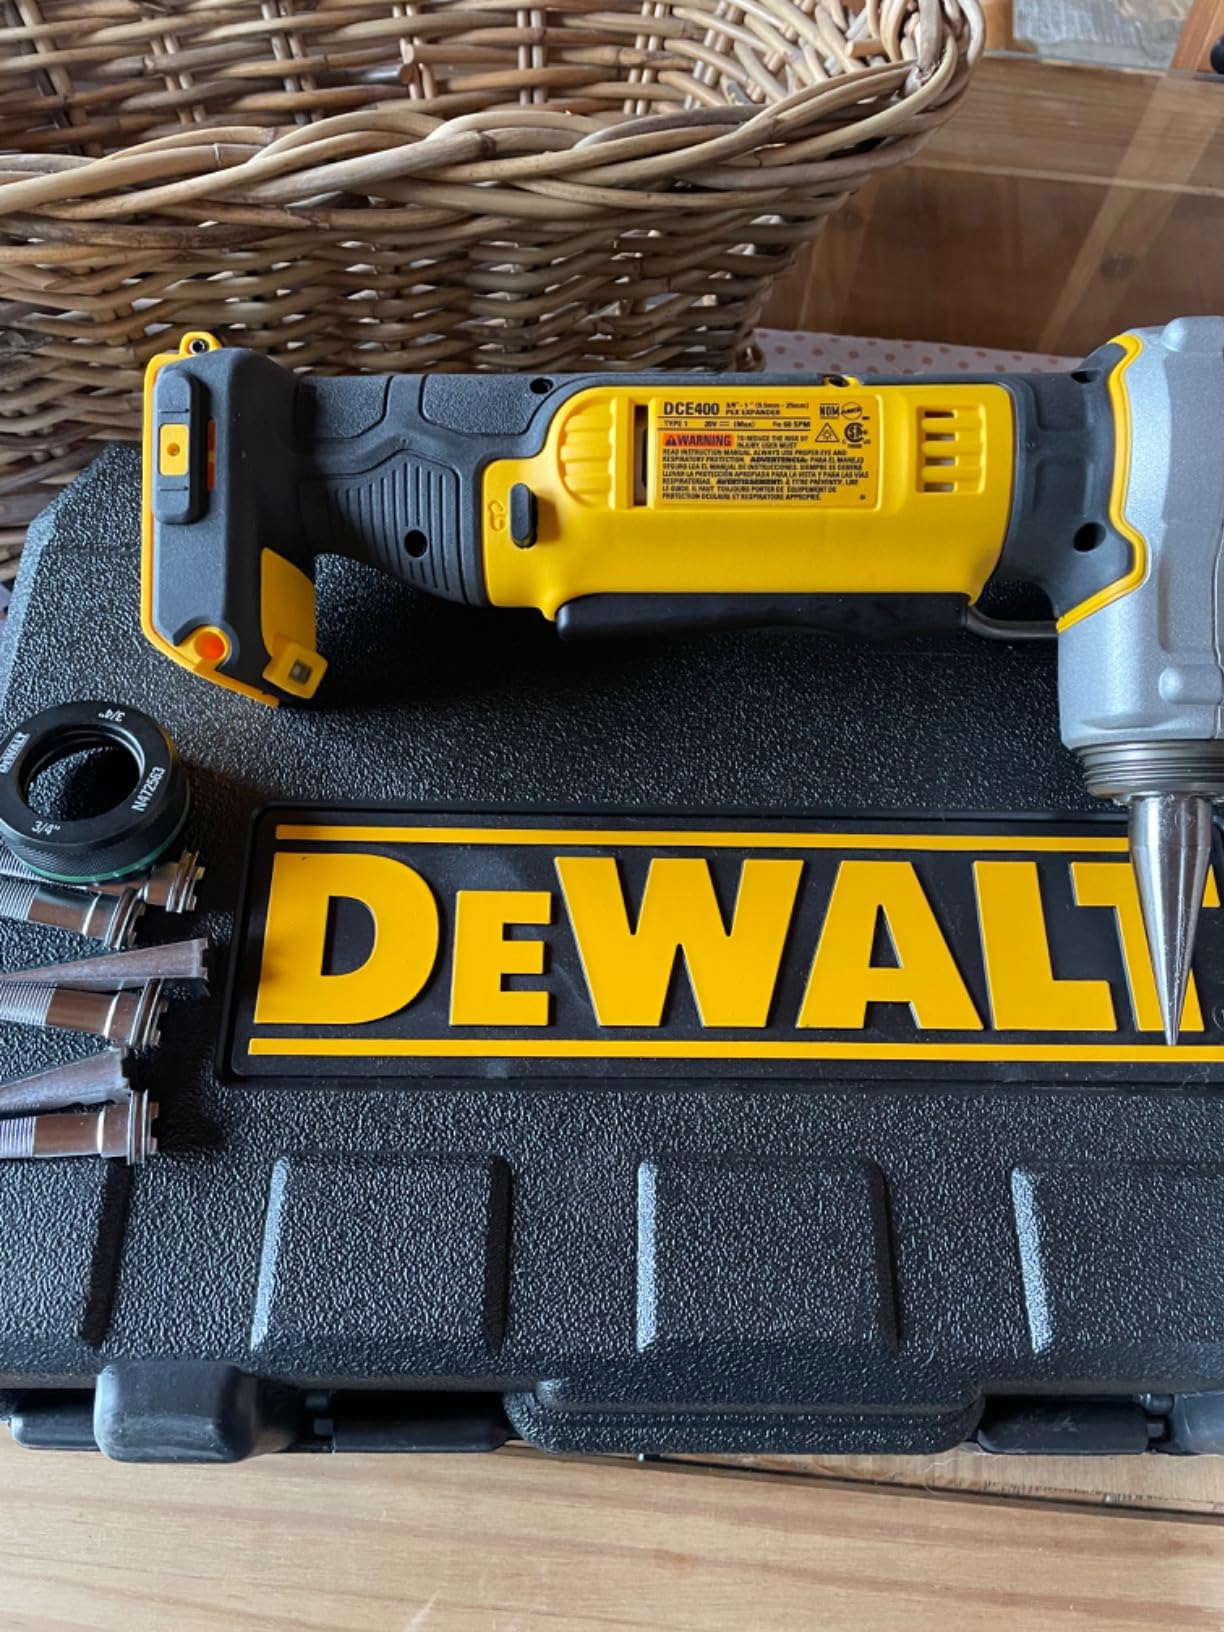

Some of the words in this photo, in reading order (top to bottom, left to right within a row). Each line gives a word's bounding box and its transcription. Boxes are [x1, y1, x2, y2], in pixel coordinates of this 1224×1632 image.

[664, 401, 720, 416] DCE400
[820, 406, 839, 416] NOM
[677, 434, 732, 446] WARNING
[130, 766, 166, 812] N472563
[31, 820, 60, 836] 3/4"
